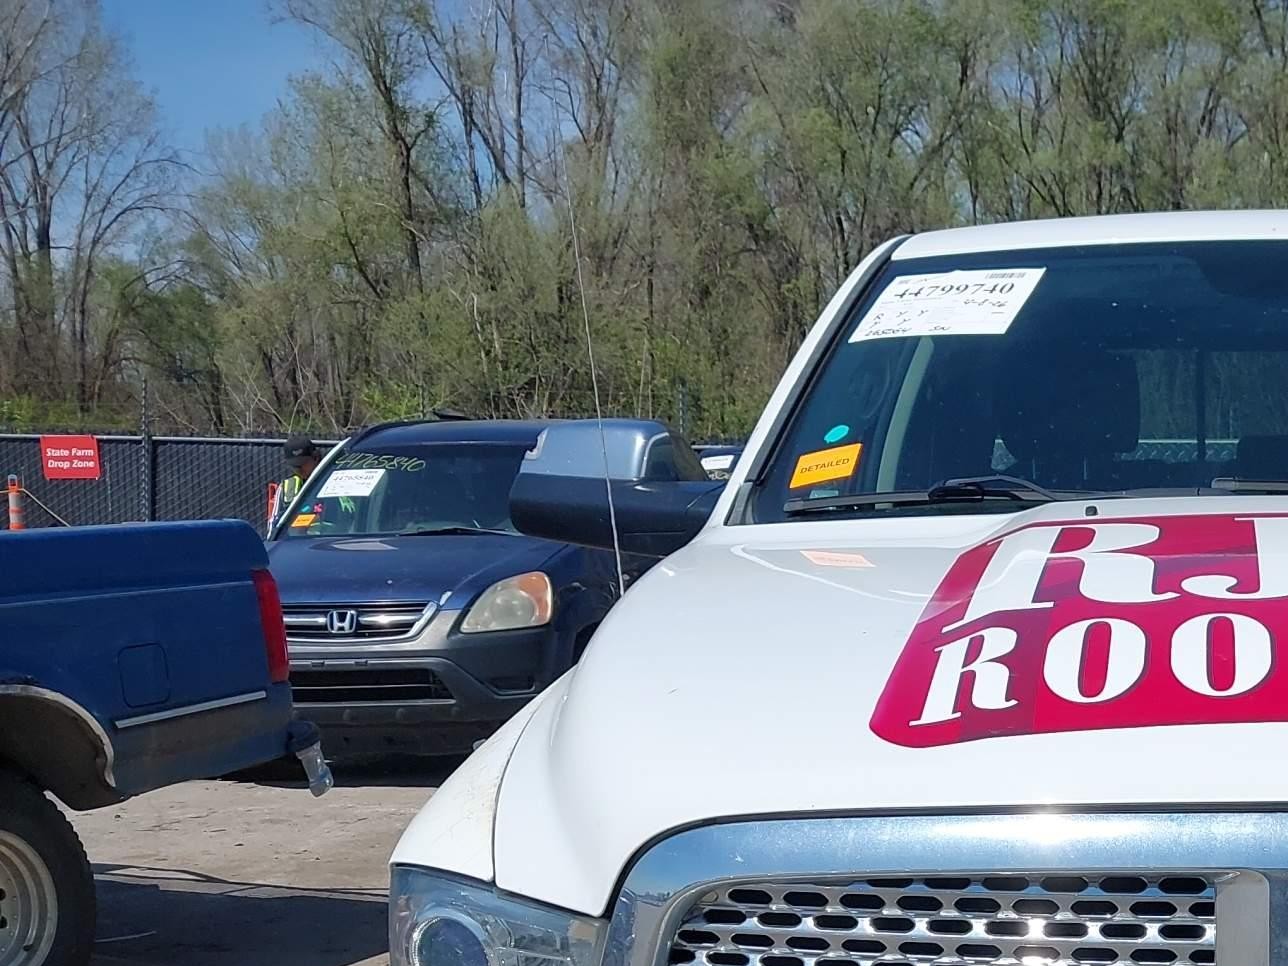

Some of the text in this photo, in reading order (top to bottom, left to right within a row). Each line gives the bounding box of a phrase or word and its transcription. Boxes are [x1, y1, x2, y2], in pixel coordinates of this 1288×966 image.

[895, 282, 1015, 298] 44799740
[46, 448, 94, 456] State Farm
[48, 459, 95, 469] Drop Zone
[799, 458, 850, 474] DETAILED
